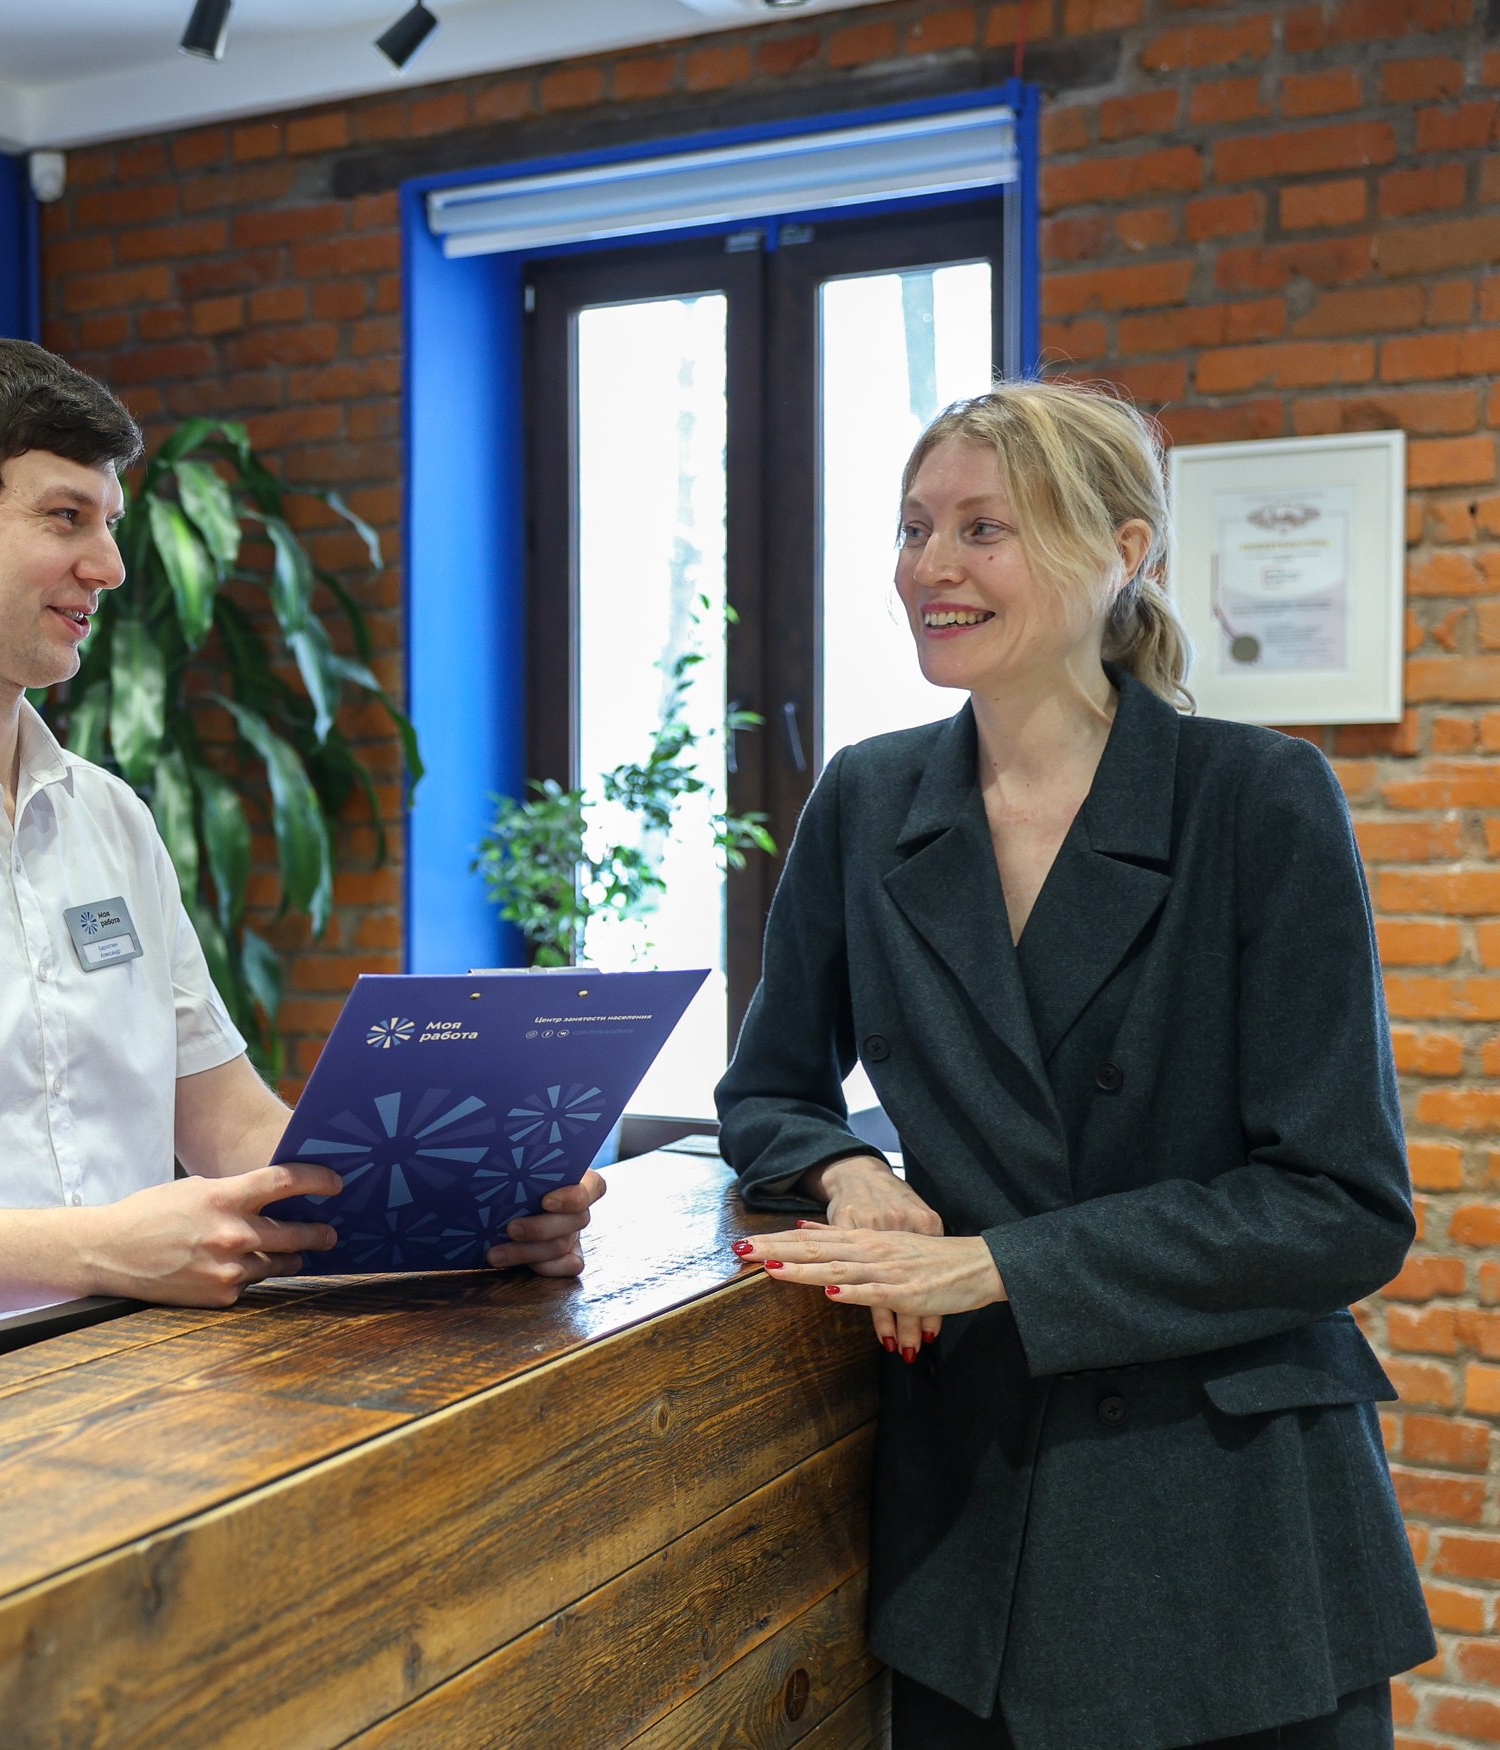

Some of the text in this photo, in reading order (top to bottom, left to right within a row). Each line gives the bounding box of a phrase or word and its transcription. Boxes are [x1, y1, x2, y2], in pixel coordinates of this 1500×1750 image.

[97, 911, 111, 919] Моя
[100, 917, 121, 928] работа
[534, 1016, 562, 1024] Центр
[425, 1021, 462, 1030] Моя
[418, 1031, 479, 1043] работа
